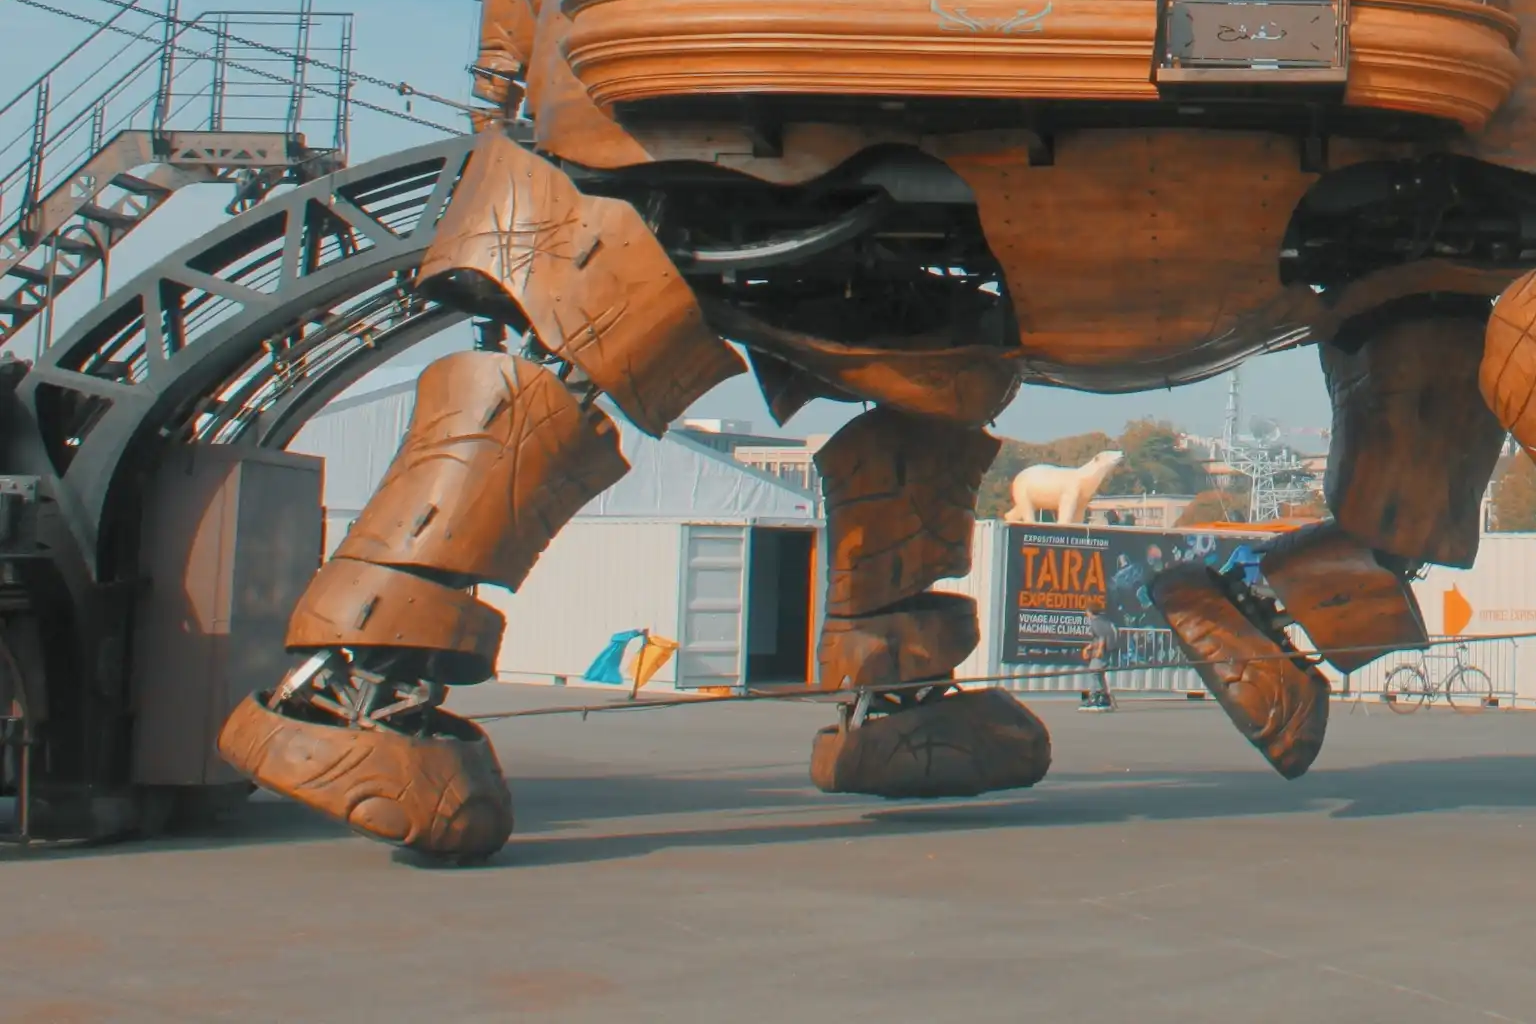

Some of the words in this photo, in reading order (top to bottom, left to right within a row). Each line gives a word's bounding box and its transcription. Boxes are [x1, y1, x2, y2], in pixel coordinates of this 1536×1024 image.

[1023, 534, 1065, 544] EXPOSITION
[1021, 547, 1107, 593] TARA
[1019, 613, 1048, 624] VOYAGE
[1048, 615, 1059, 624] AU
[1060, 615, 1082, 625] CŒUR
[1018, 623, 1056, 634] MACHINE
